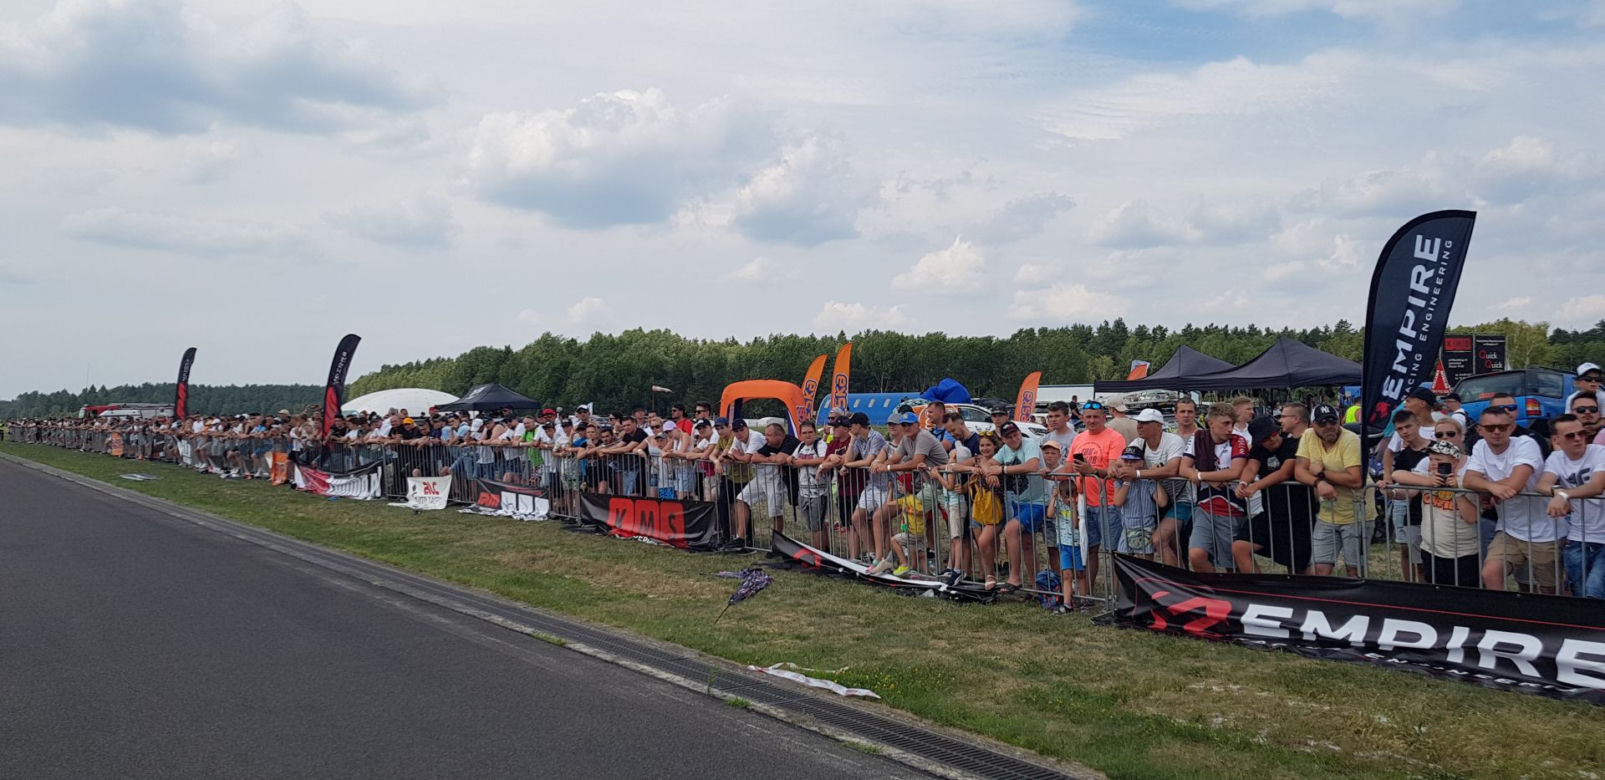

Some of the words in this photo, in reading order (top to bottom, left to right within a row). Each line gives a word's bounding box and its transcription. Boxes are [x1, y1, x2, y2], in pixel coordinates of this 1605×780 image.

[1382, 234, 1442, 400] EMPIRE
[1419, 239, 1453, 342] ENGINEERING
[1478, 349, 1498, 360] Quick
[1484, 360, 1504, 370] Quick
[614, 507, 680, 539] KMS
[1240, 603, 1605, 690] EMPIRE
